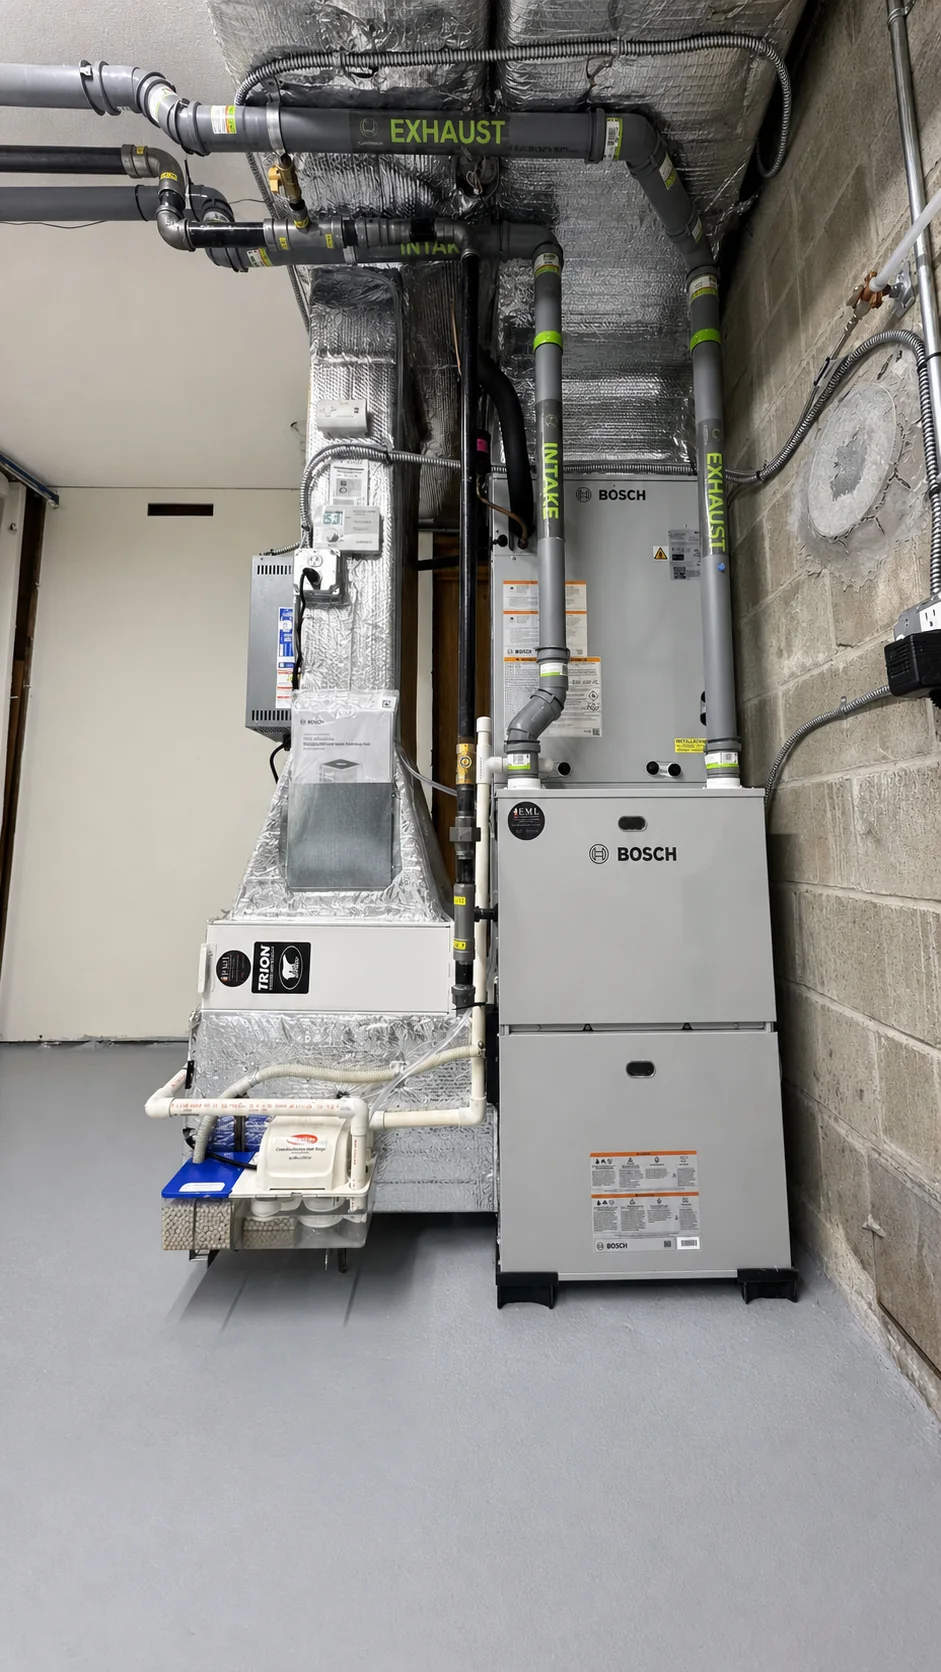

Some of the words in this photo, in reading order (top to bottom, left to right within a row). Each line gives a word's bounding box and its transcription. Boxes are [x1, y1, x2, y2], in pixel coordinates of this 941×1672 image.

[390, 118, 506, 144] EXHAUST
[401, 241, 461, 255] INTAK
[542, 442, 559, 520] INTAKE
[598, 489, 646, 501] BOSCH
[706, 452, 726, 552] EXHAUST
[617, 846, 677, 862] BOSCH
[258, 944, 271, 990] TRION
